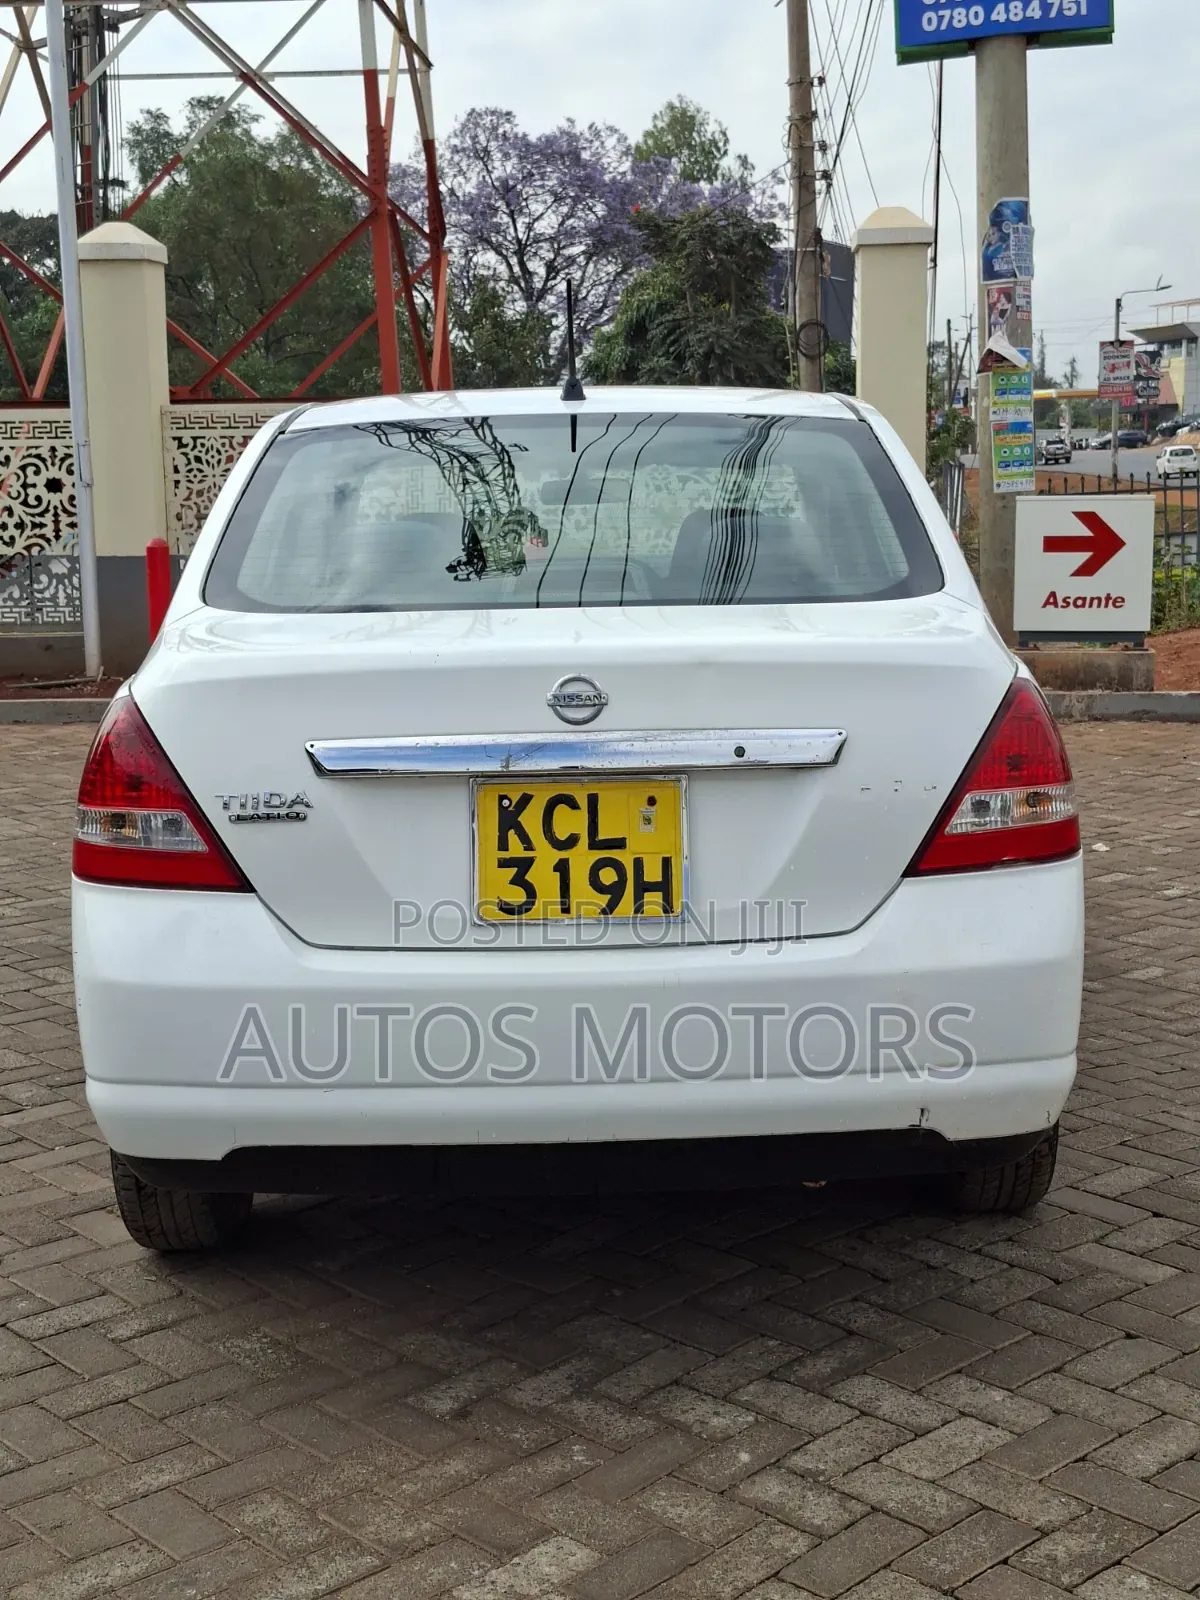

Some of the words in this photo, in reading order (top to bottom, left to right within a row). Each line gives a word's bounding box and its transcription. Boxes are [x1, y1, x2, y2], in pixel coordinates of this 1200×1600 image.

[922, 5, 985, 32] 0780
[990, 0, 1042, 22] 484
[1047, 0, 1087, 18] 751
[1041, 590, 1126, 609] Asante
[553, 694, 602, 703] NISSAN
[214, 790, 314, 810] TIIDA
[234, 811, 302, 822] LATIO
[497, 792, 627, 852] KCL
[497, 856, 674, 916] 319H
